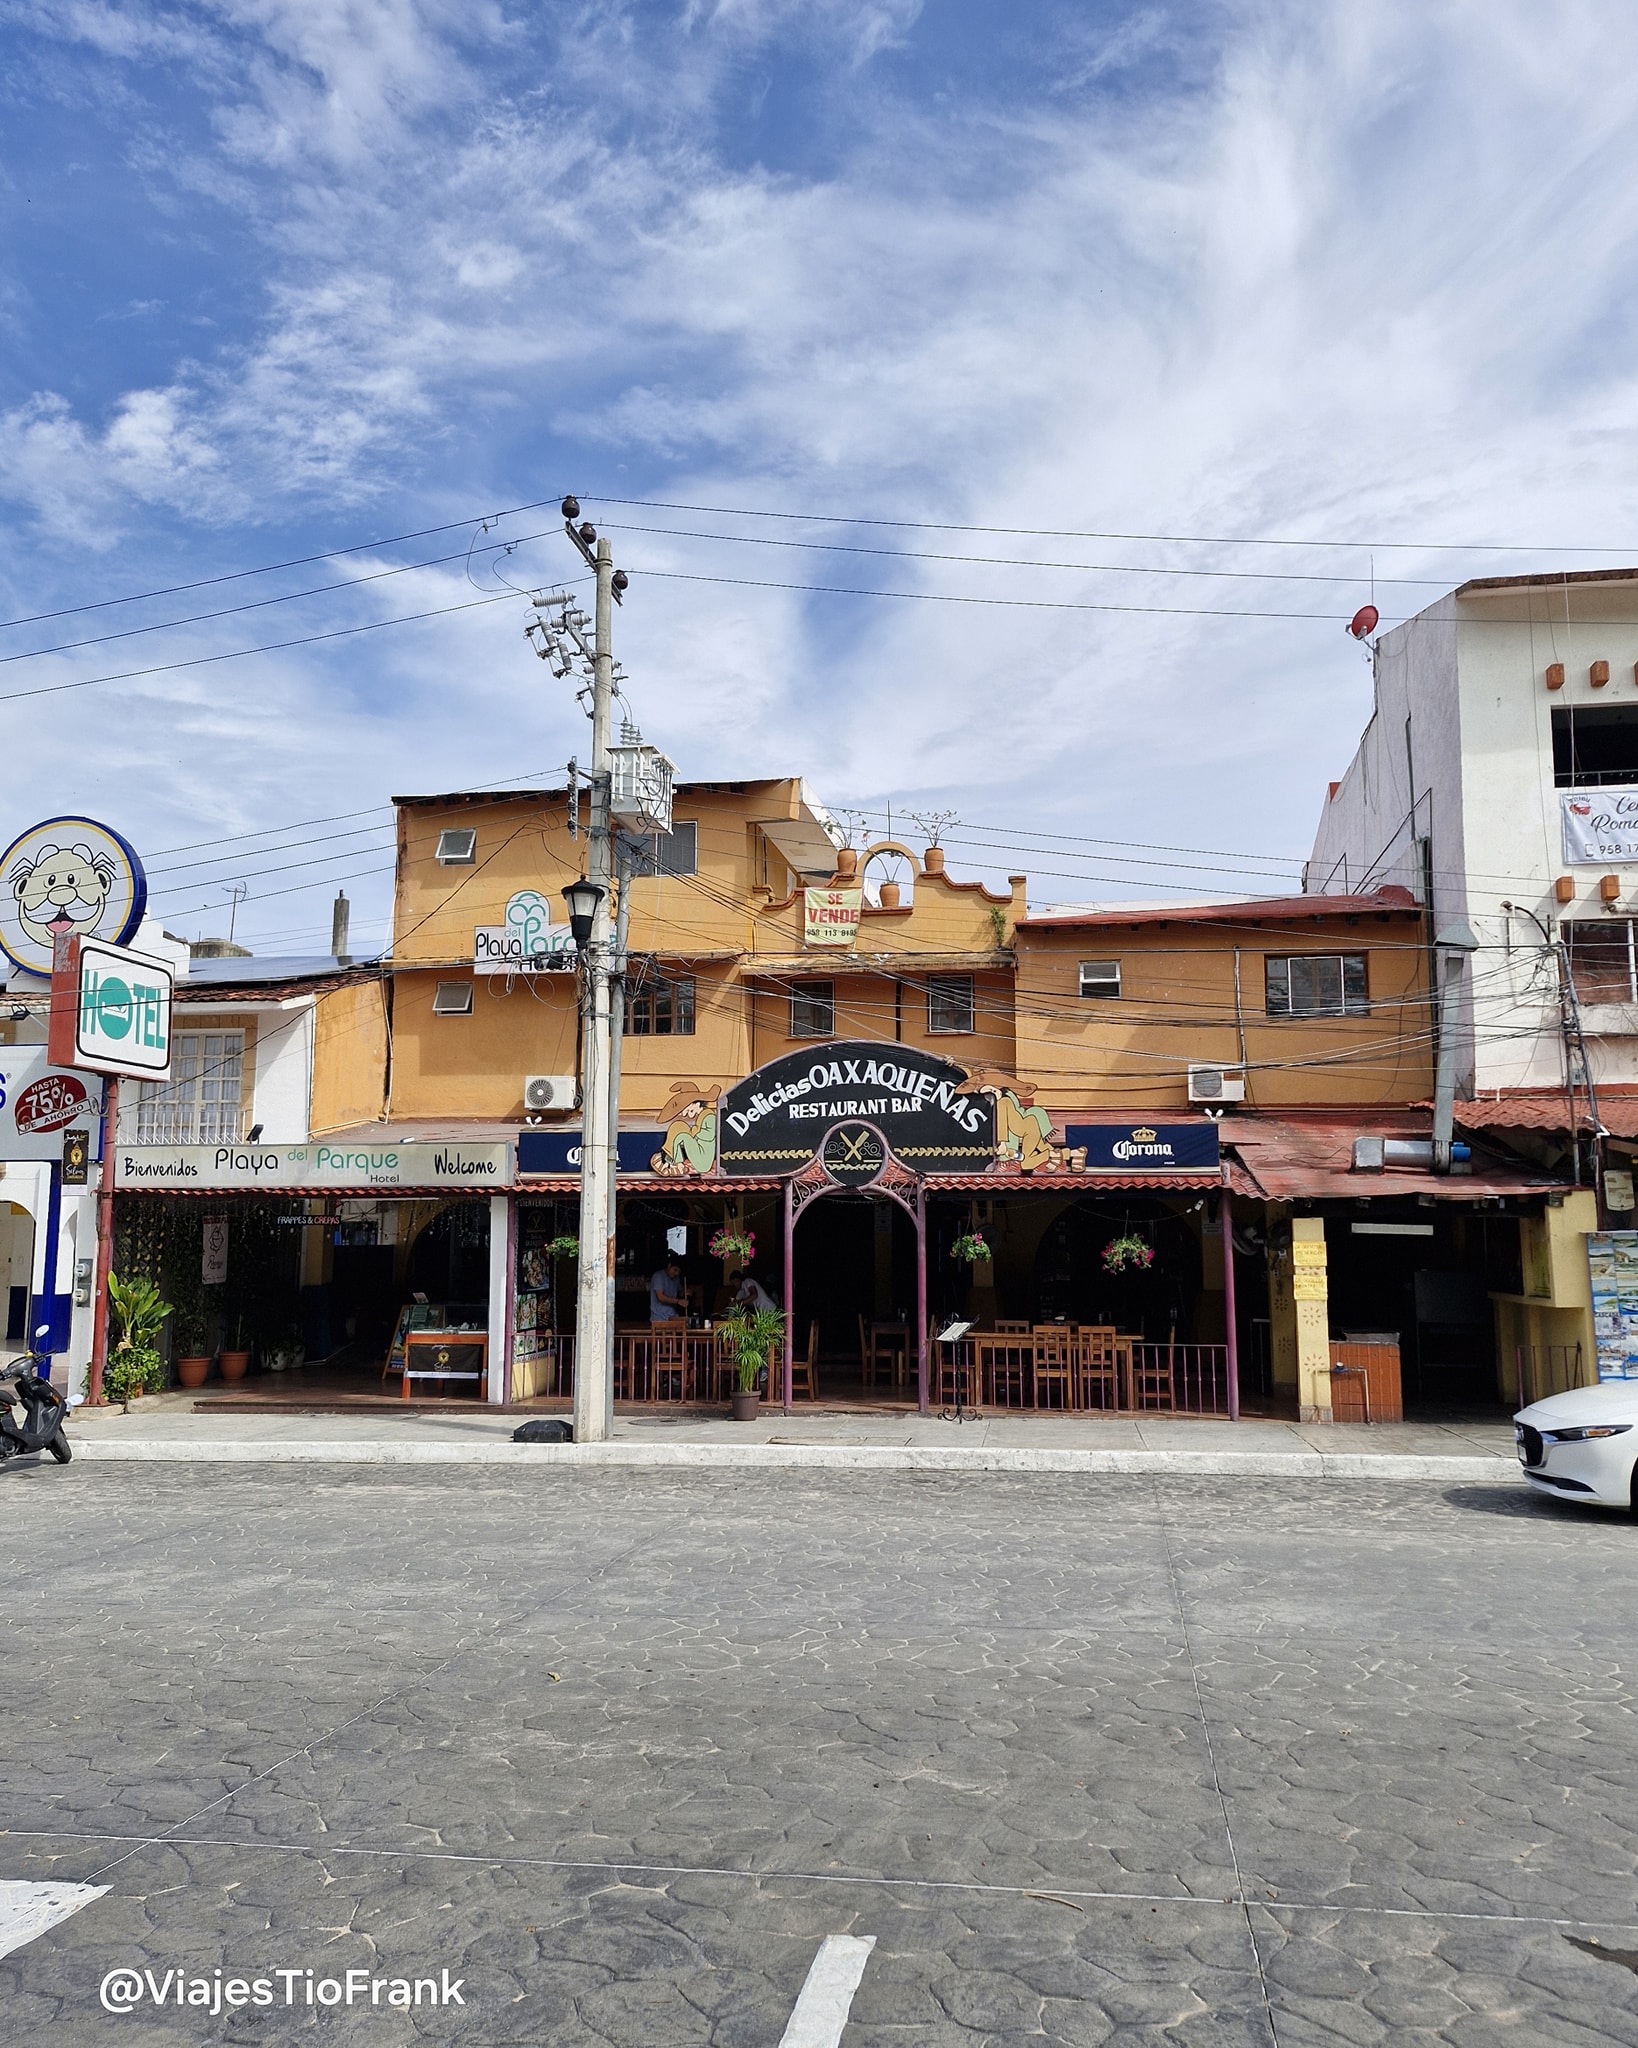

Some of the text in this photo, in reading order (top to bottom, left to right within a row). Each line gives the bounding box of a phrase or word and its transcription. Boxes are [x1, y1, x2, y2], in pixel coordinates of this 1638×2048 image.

[1600, 844, 1622, 855] 958
[828, 892, 843, 905] SE
[808, 908, 859, 924] VENDE
[825, 929, 837, 937] 113
[476, 932, 521, 961] Playa
[504, 927, 521, 938] del
[82, 969, 166, 1050] HOTEL
[31, 1078, 60, 1093] HASTA
[25, 1083, 74, 1119] 75%
[725, 1059, 988, 1137] Delicias OAXAQUEÑAS
[789, 1097, 922, 1119] RESTAURANT BAR
[1112, 1140, 1175, 1161] Corona
[124, 1157, 198, 1177] Bienvenidos
[215, 1148, 399, 1175] Playa del Parque
[434, 1148, 497, 1175] Welcome
[370, 1174, 400, 1183] Hotel
[307, 1216, 314, 1224] &
[314, 1216, 340, 1224] CREPAS
